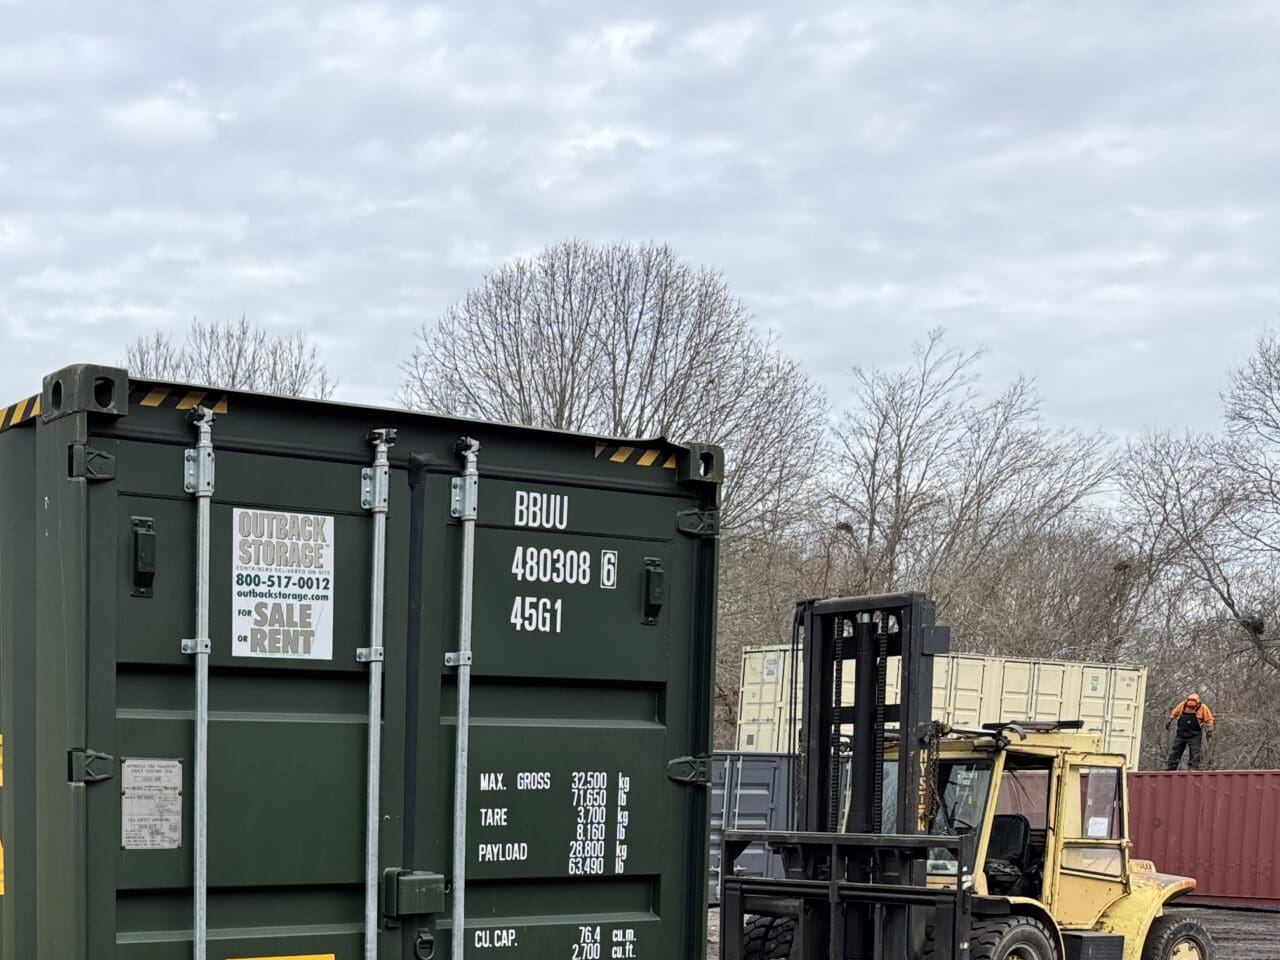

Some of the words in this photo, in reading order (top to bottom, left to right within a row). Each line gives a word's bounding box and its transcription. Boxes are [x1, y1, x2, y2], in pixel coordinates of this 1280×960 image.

[514, 490, 568, 529] BBUU
[238, 511, 327, 543] OUTBACK
[238, 539, 324, 569] STORAGE
[511, 546, 591, 585] 480308
[601, 551, 616, 587] 6
[236, 573, 330, 590] 800-517-0012
[237, 588, 329, 602] outbackstorage.com
[238, 609, 252, 617] FOR
[254, 601, 312, 629] SALE
[510, 596, 562, 633] 45G1
[250, 628, 315, 654] RENT
[480, 773, 507, 791] MAX.
[517, 772, 551, 789] GROSS
[572, 772, 607, 790] 32,500
[618, 772, 630, 792] kg
[571, 790, 607, 807] 71,650
[618, 790, 627, 806] lb
[480, 808, 508, 826] TARE
[577, 807, 606, 824] 3,700
[617, 808, 629, 826] kg
[576, 824, 605, 840] 8,160
[616, 824, 625, 840] lb
[478, 843, 528, 862] PAYLOAD
[569, 841, 605, 858] 28,800
[616, 841, 628, 860] kg
[568, 858, 604, 875] 63,490
[615, 858, 624, 874] lb
[579, 926, 600, 943] 76.4
[572, 943, 600, 960] 2,700
